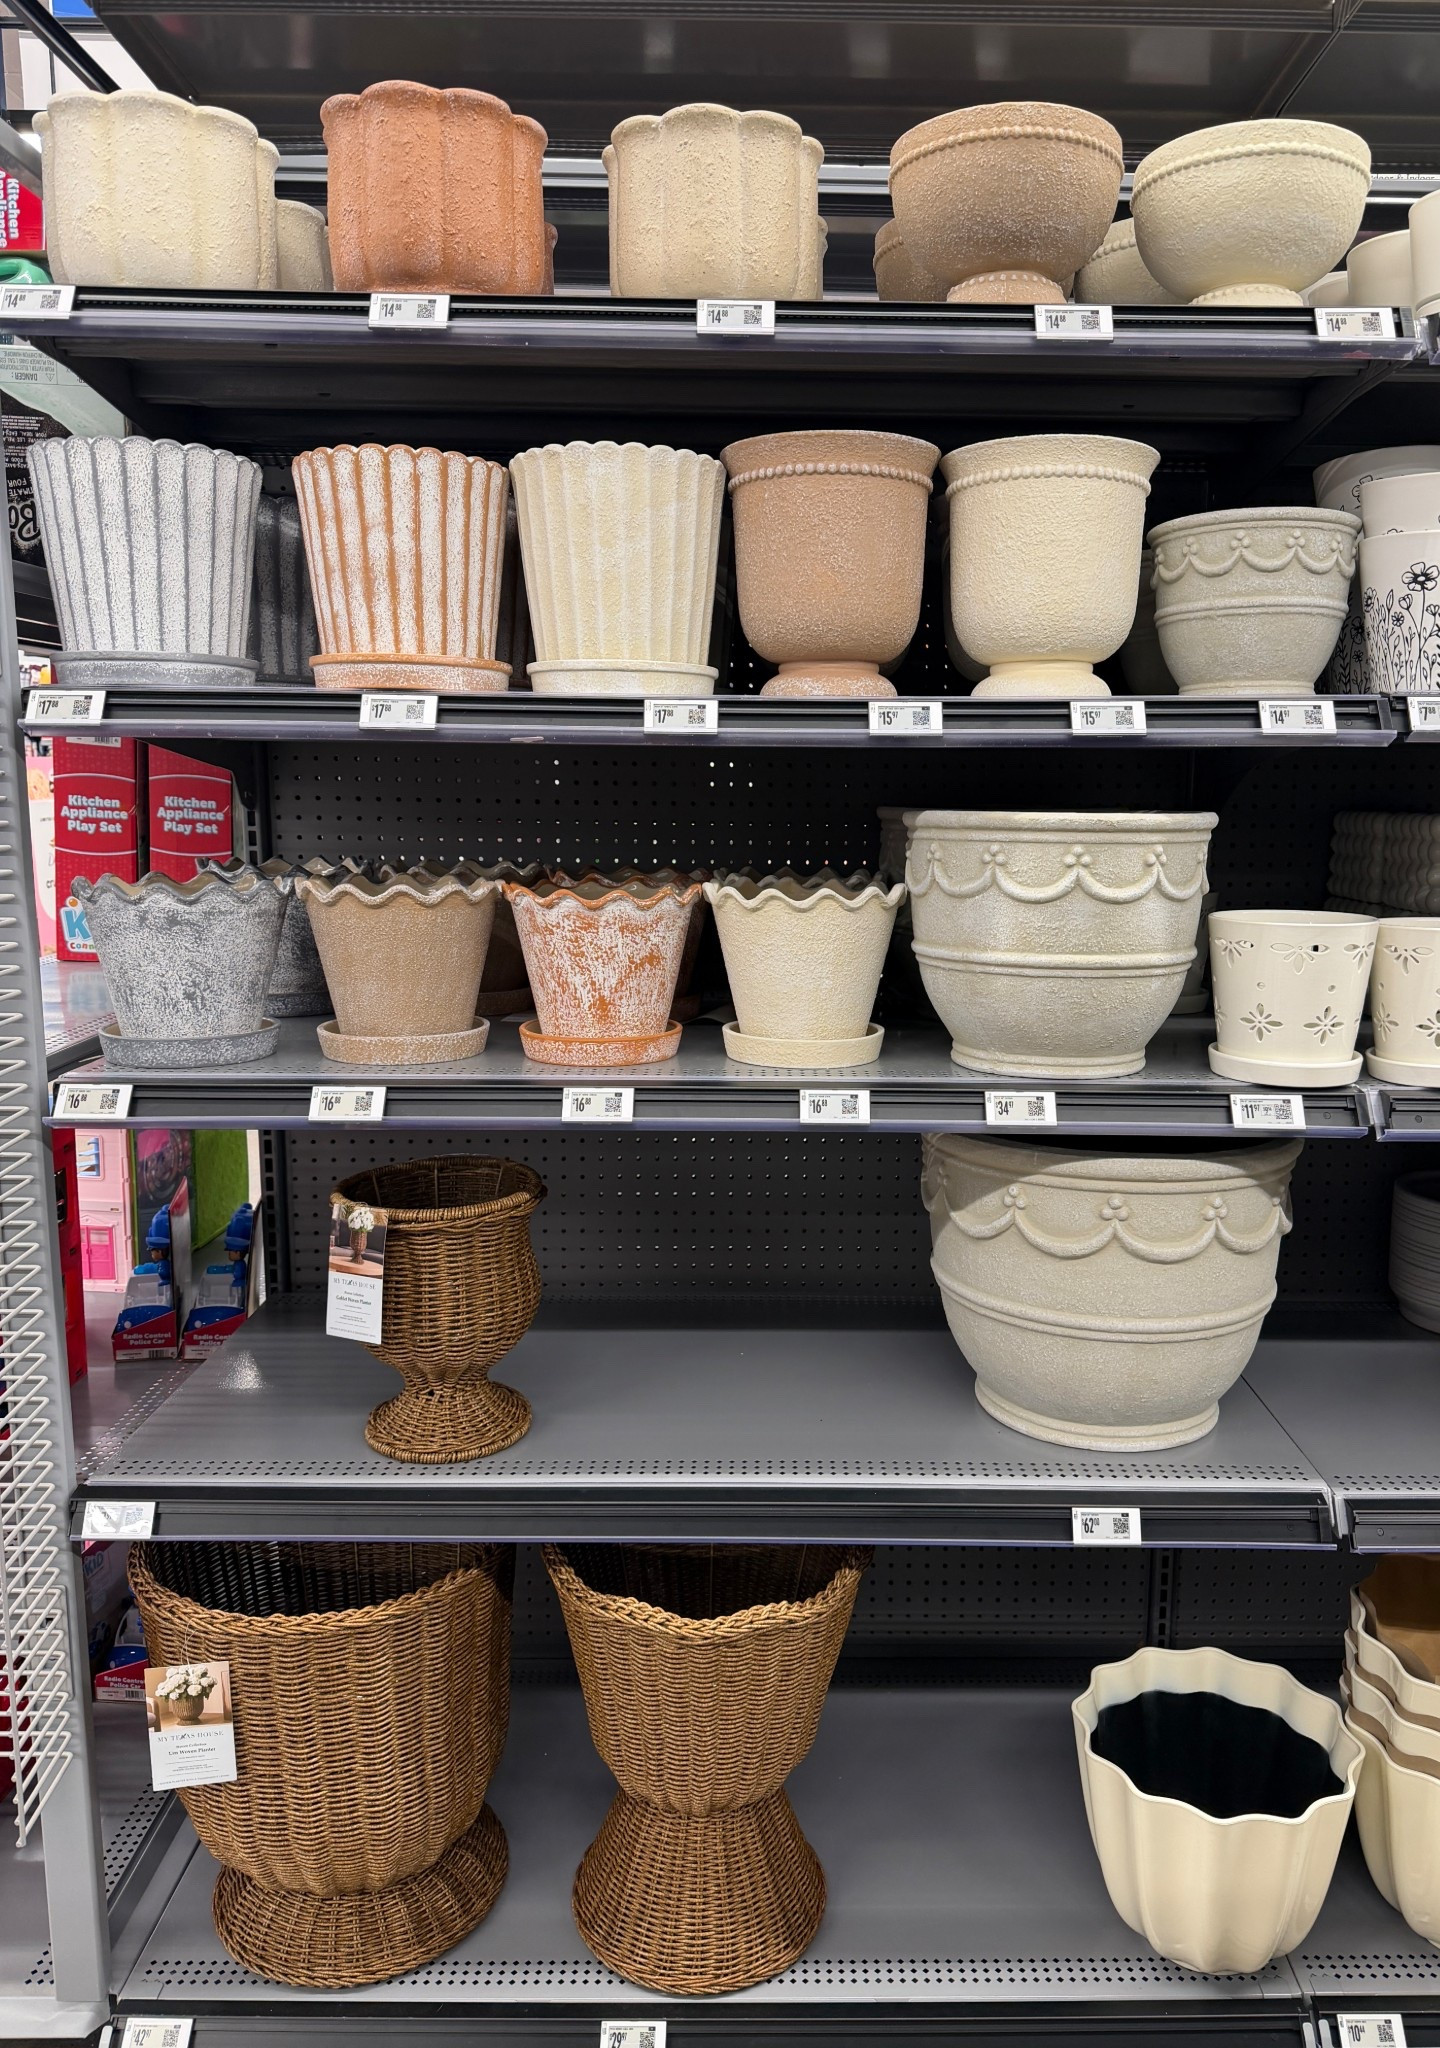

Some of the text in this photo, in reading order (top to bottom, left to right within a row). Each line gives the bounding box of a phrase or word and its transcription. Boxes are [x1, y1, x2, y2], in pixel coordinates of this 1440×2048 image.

[7, 178, 20, 239] Kitchen
[68, 794, 121, 808] Kitchen
[164, 795, 217, 809] Kitchen
[60, 806, 129, 820] Appliance
[156, 807, 224, 820] Appliance
[67, 820, 122, 835] Play Set
[163, 820, 218, 835] Play Set
[84, 1551, 104, 1576] KID
[104, 1675, 144, 1685] Radio Contro
[170, 1733, 195, 1741] TEXAS
